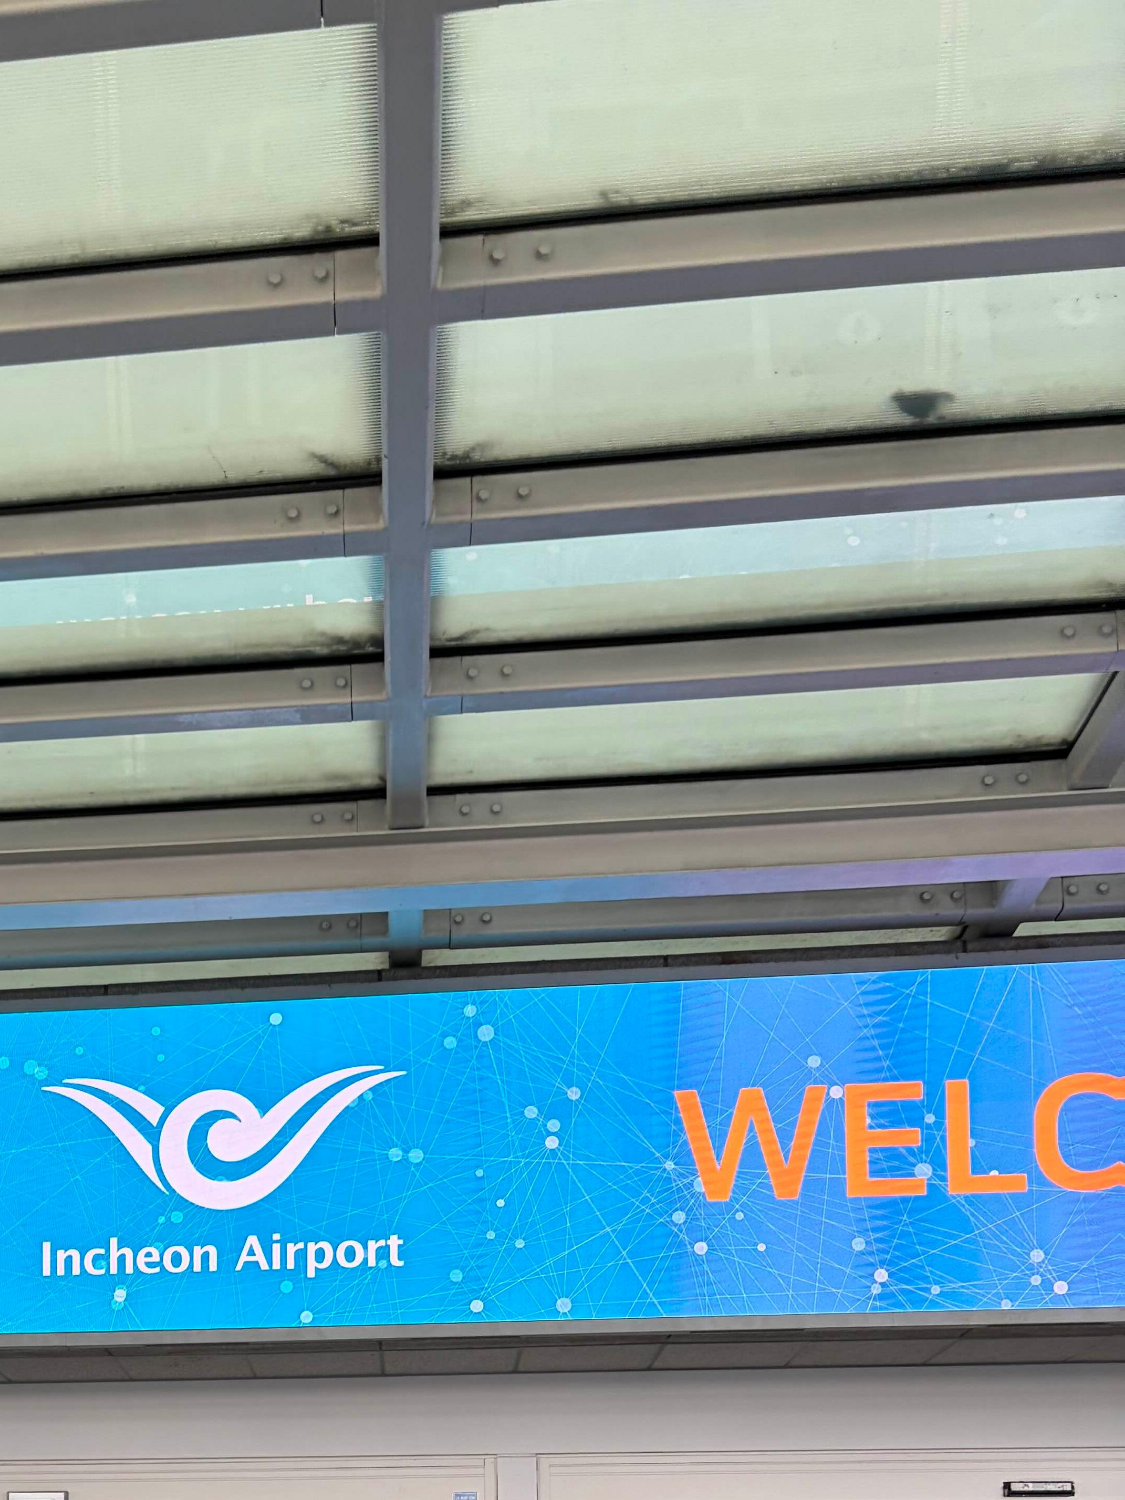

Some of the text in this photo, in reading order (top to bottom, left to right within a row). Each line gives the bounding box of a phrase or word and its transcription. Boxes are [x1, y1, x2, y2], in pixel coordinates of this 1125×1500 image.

[675, 1073, 1125, 1201] WELC
[42, 1233, 404, 1279] Incheon Airport
